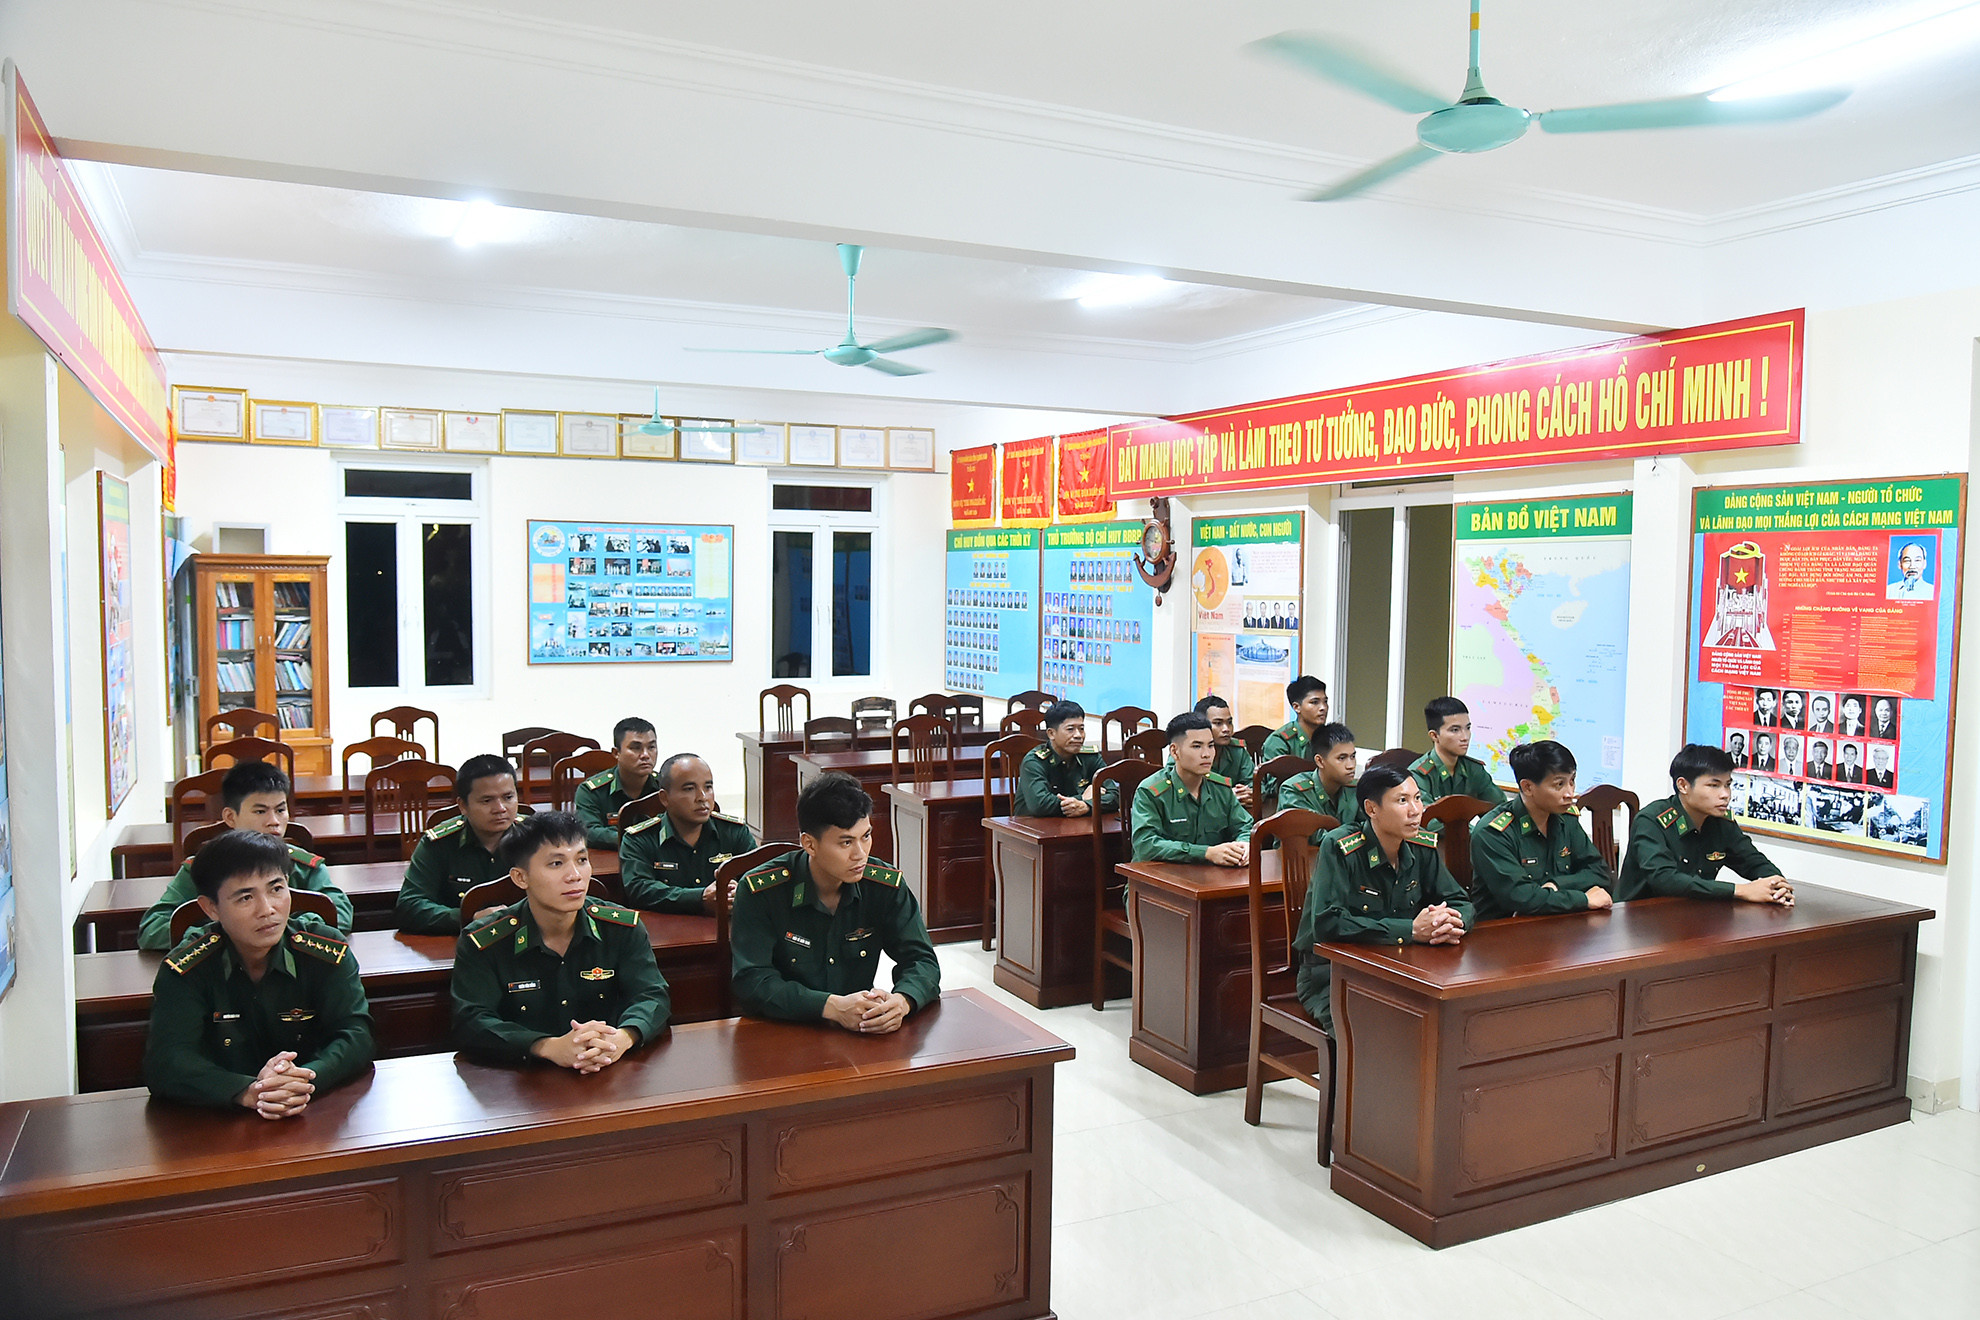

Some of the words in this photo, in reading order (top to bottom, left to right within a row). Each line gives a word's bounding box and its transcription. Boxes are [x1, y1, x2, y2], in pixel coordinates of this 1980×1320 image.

[1118, 431, 1138, 483] ĐẨY
[1140, 441, 1170, 488] MẠNH
[1172, 437, 1194, 485] HỌC
[1196, 426, 1218, 483] TẬP
[1220, 423, 1236, 472] VÀ
[1238, 420, 1266, 470] LÀM
[1269, 420, 1302, 467] THEO
[1305, 414, 1324, 463] TƯ
[1326, 398, 1378, 462] TƯỞNG,
[1383, 405, 1416, 465] ĐẠO
[1420, 391, 1460, 455] ĐỨC,
[1466, 389, 1530, 447] PHONG
[1536, 374, 1592, 440] CÁCH
[1598, 356, 1628, 433] HỒ
[1635, 356, 1676, 430] CHÍ
[1682, 358, 1752, 425] MINH
[1760, 356, 1769, 417] !
[1724, 492, 1747, 509] ĐẢNG
[1750, 493, 1773, 510] CỘNG
[1775, 490, 1793, 507] SẢN
[1796, 490, 1814, 508] VIỆT
[1817, 492, 1839, 505] NAM
[1848, 487, 1878, 504] NGƯỜI
[1880, 484, 1893, 503] TỔ
[1895, 485, 1923, 502] CHỨC
[1471, 506, 1503, 532] BẢN
[1507, 504, 1529, 530] ĐỒ
[1534, 505, 1570, 532] VIỆT
[1574, 506, 1617, 528] NAM
[1700, 515, 1710, 530] VÀ
[1712, 515, 1734, 529] LÃNH
[1736, 516, 1753, 532] ĐẠO
[1755, 515, 1772, 531] MỌI
[1774, 510, 1802, 528] THẮNG
[1804, 513, 1819, 530] LỢI
[1821, 509, 1840, 527] CỦA
[1842, 510, 1869, 526] CÁCH
[1871, 511, 1902, 529] MẠNG
[1904, 508, 1926, 528] VIỆT
[1928, 510, 1953, 524] NAM
[997, 532, 1008, 546] CÁC
[1085, 529, 1094, 547] BỘ
[1108, 530, 1121, 544] HUY
[1200, 524, 1211, 542] VIỆT
[1212, 526, 1225, 539] NAM
[1230, 520, 1240, 538] ĐẤT
[1260, 523, 1272, 537] CON
[1273, 519, 1292, 536] NGƯỜI
